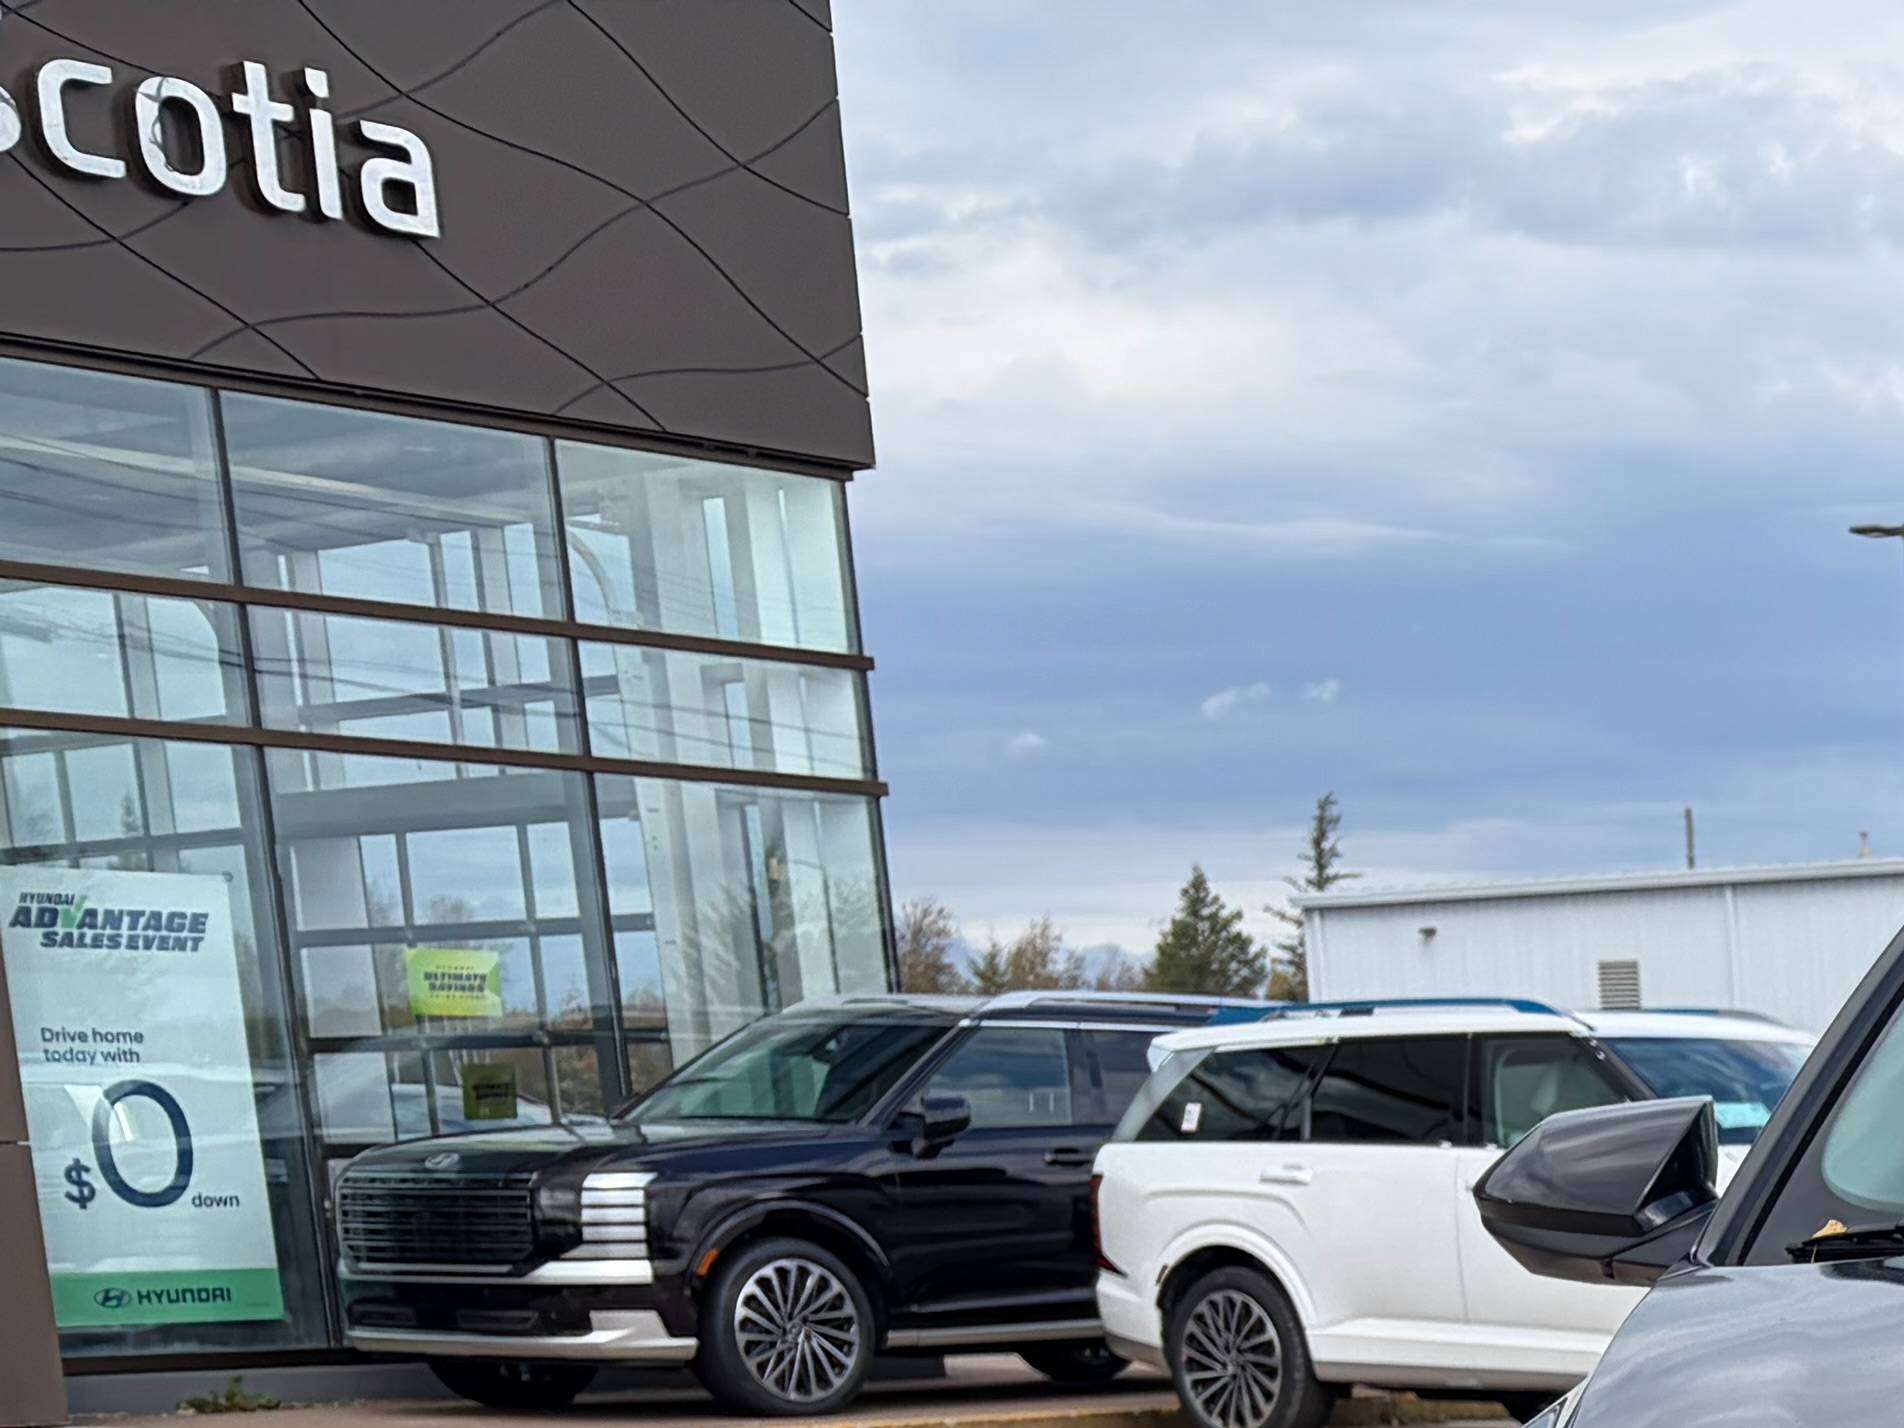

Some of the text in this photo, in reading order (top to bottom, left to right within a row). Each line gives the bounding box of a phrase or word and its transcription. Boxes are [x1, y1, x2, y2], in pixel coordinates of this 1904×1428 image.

[0, 59, 440, 238] cotia
[18, 892, 75, 906] HYUNDAI
[8, 899, 209, 934] ADVANTAGE
[40, 930, 205, 952] SALES EVENT
[41, 1027, 145, 1044] Drive home
[44, 1047, 141, 1066] today with
[191, 1191, 241, 1208] down
[137, 1287, 232, 1305] HYUNDAI
